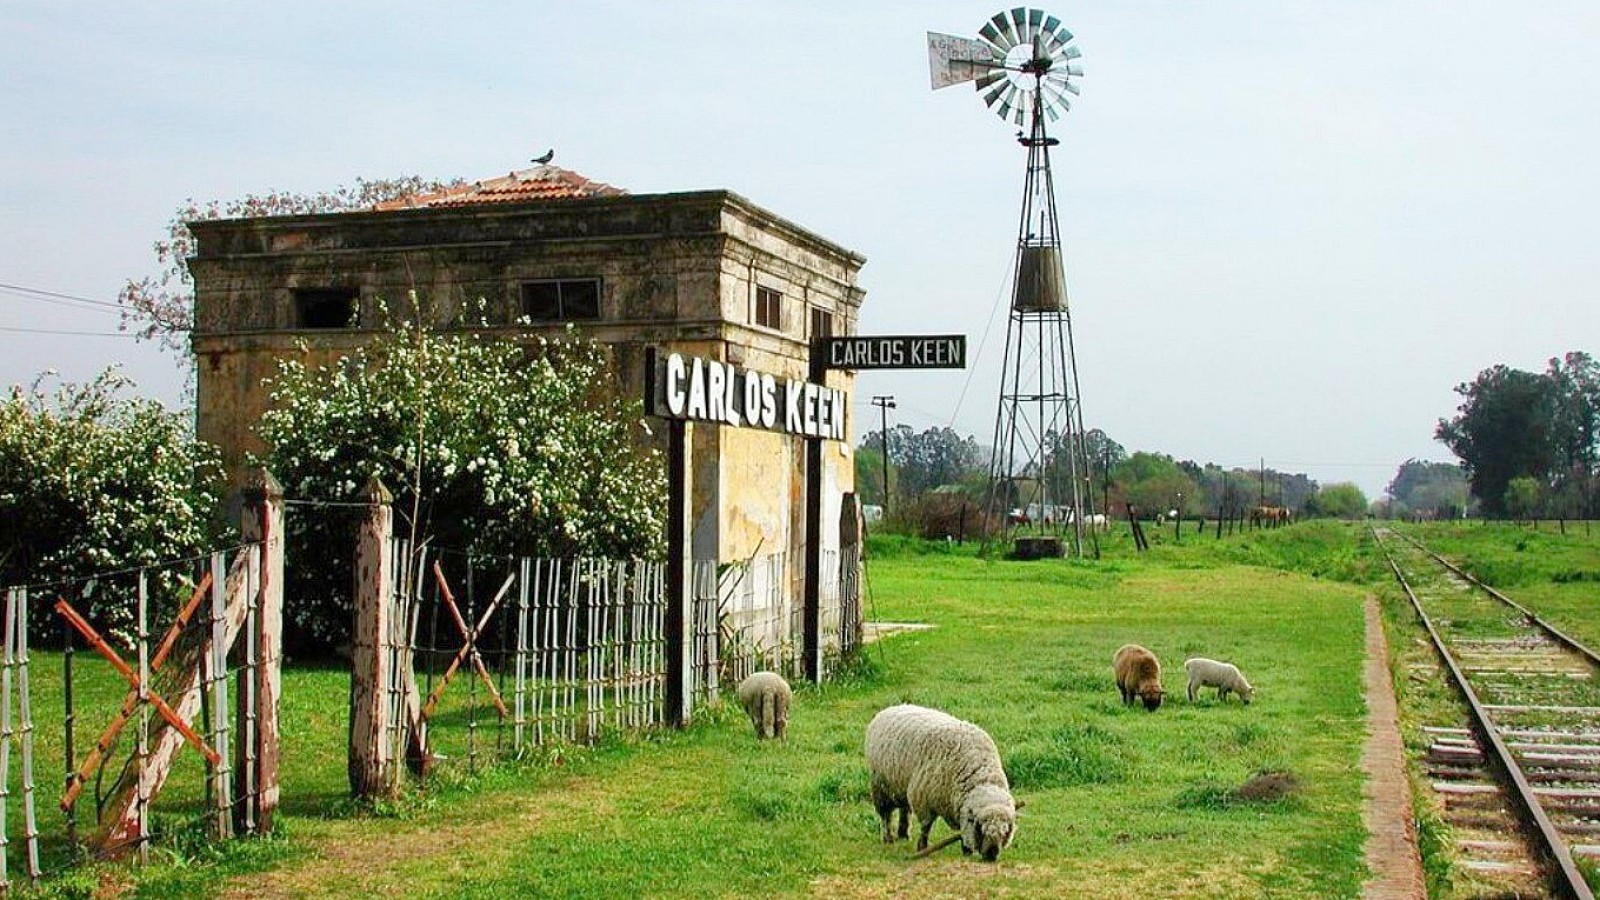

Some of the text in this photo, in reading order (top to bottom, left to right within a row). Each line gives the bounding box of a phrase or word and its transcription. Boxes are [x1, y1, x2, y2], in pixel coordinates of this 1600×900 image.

[832, 339, 961, 365] CARLOS KEEN
[667, 352, 846, 440] CARLOS KEEN
